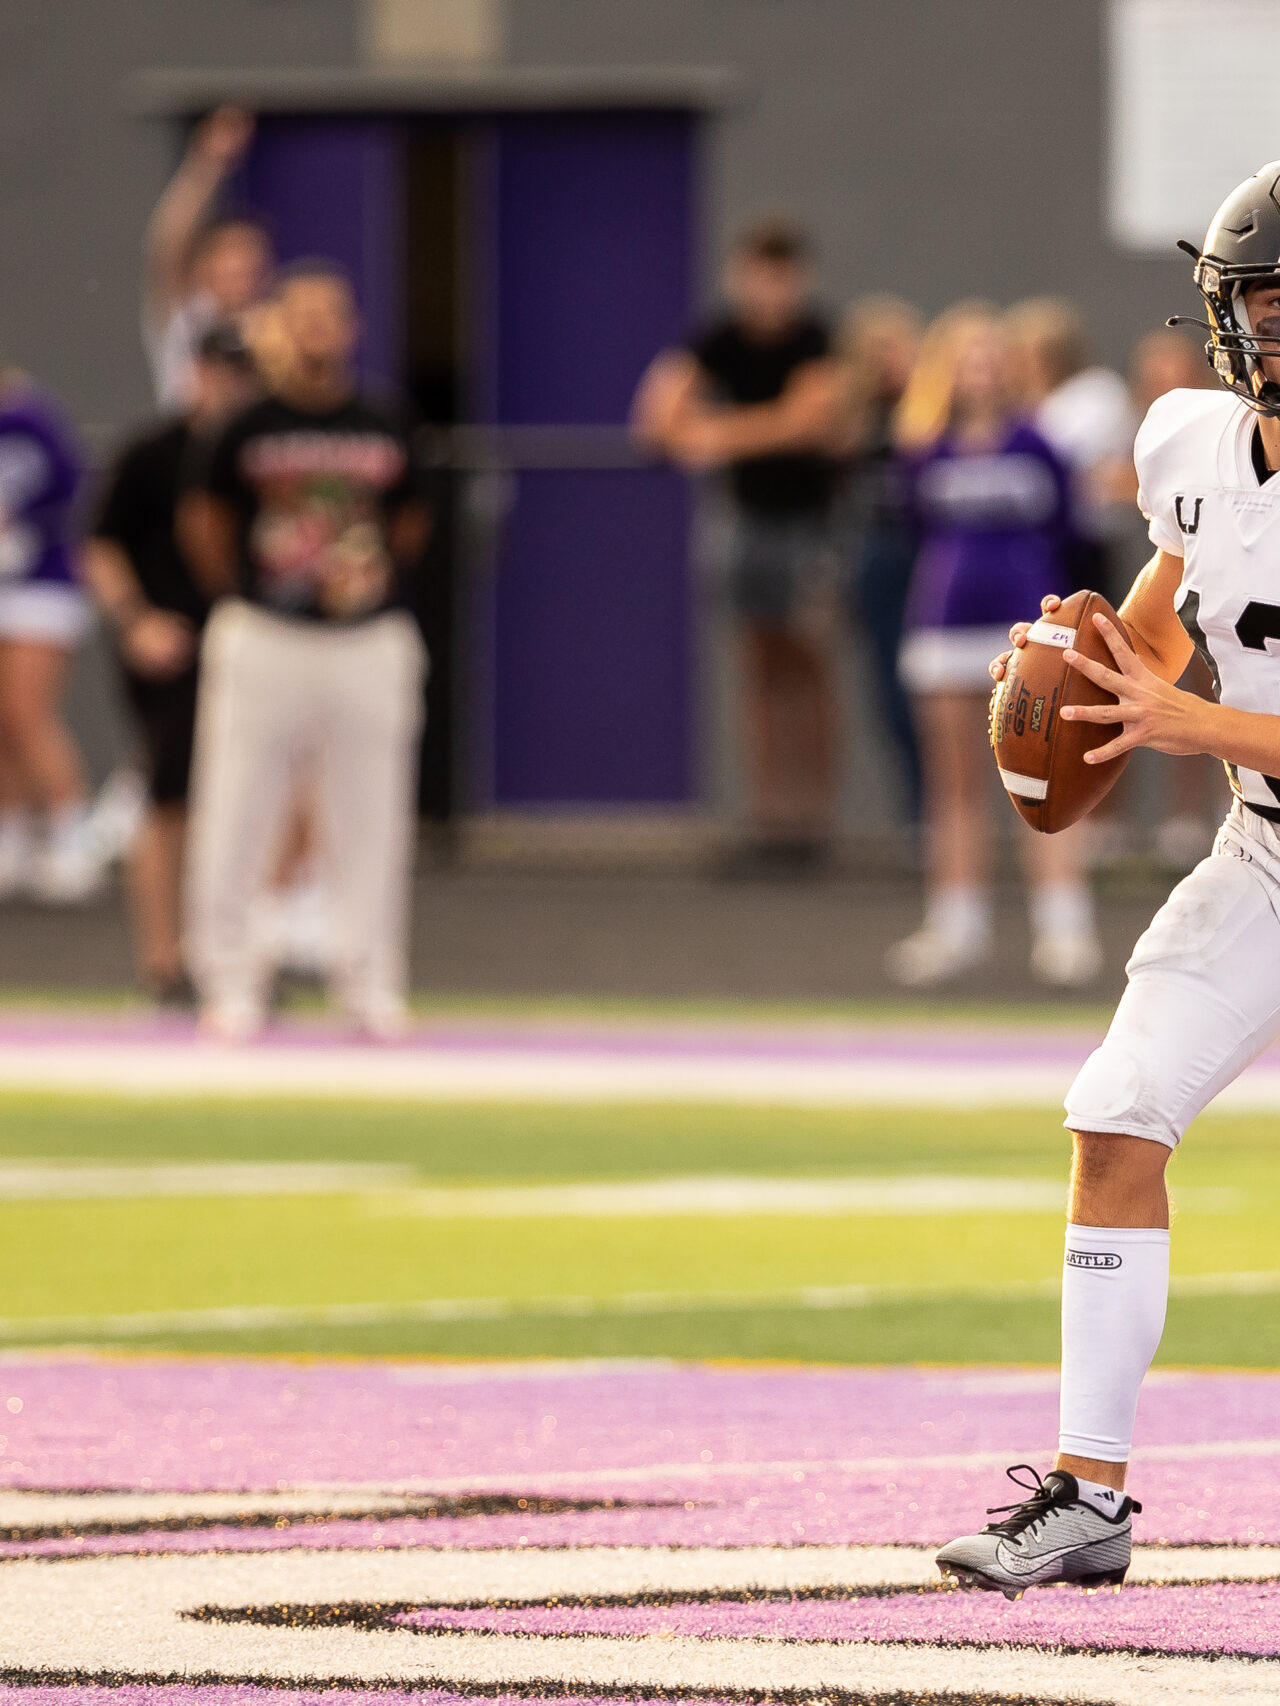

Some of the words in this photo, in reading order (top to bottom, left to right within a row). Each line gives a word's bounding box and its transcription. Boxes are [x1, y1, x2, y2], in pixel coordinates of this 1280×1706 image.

[1175, 496, 1204, 534] U
[1014, 680, 1031, 737] GST
[1031, 696, 1046, 732] NCAA
